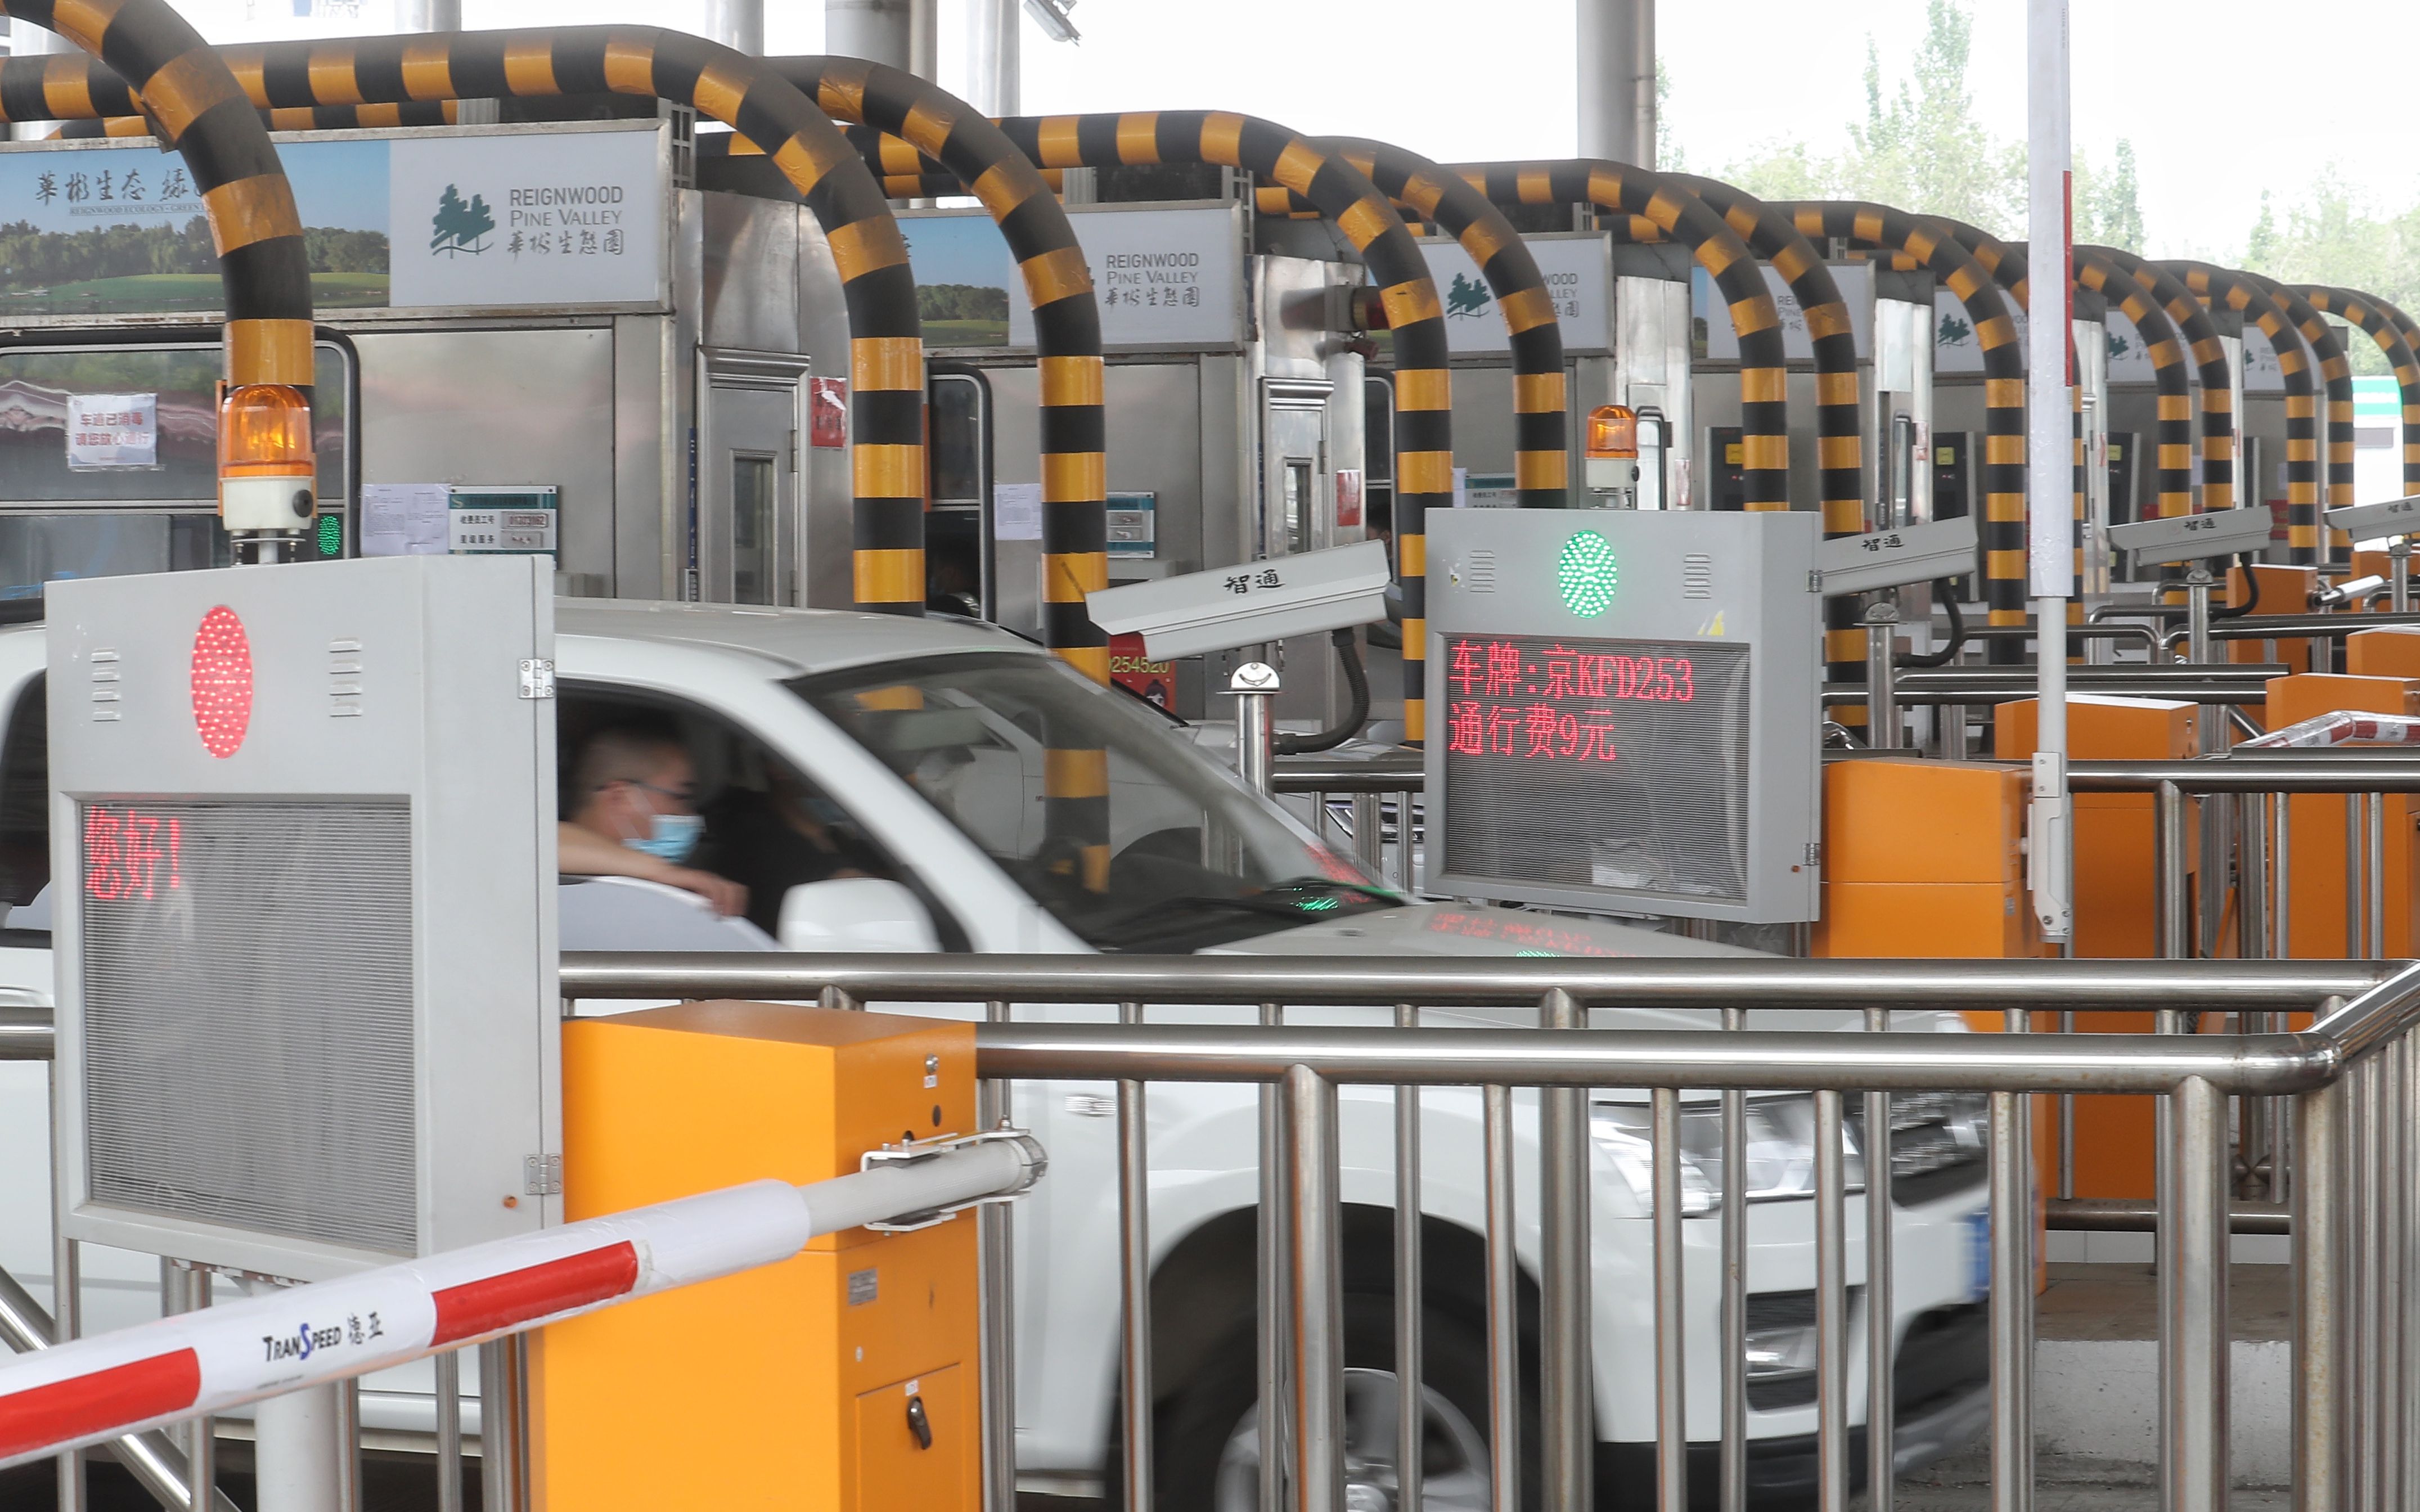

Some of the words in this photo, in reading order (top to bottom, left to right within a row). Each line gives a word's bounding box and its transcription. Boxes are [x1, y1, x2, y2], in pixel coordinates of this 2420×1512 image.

[510, 186, 623, 206] REIGNWOOD
[510, 210, 552, 227] PINE
[557, 208, 622, 226] VALLEY
[1106, 253, 1199, 268] REIGNWOOD
[1107, 271, 1141, 284] PINE
[1146, 270, 1199, 283] VALLEY
[1861, 534, 1905, 552] 智通
[1223, 568, 1287, 594] 智通
[1109, 656, 1170, 673] 254520
[1449, 701, 1617, 761] 通行费9元
